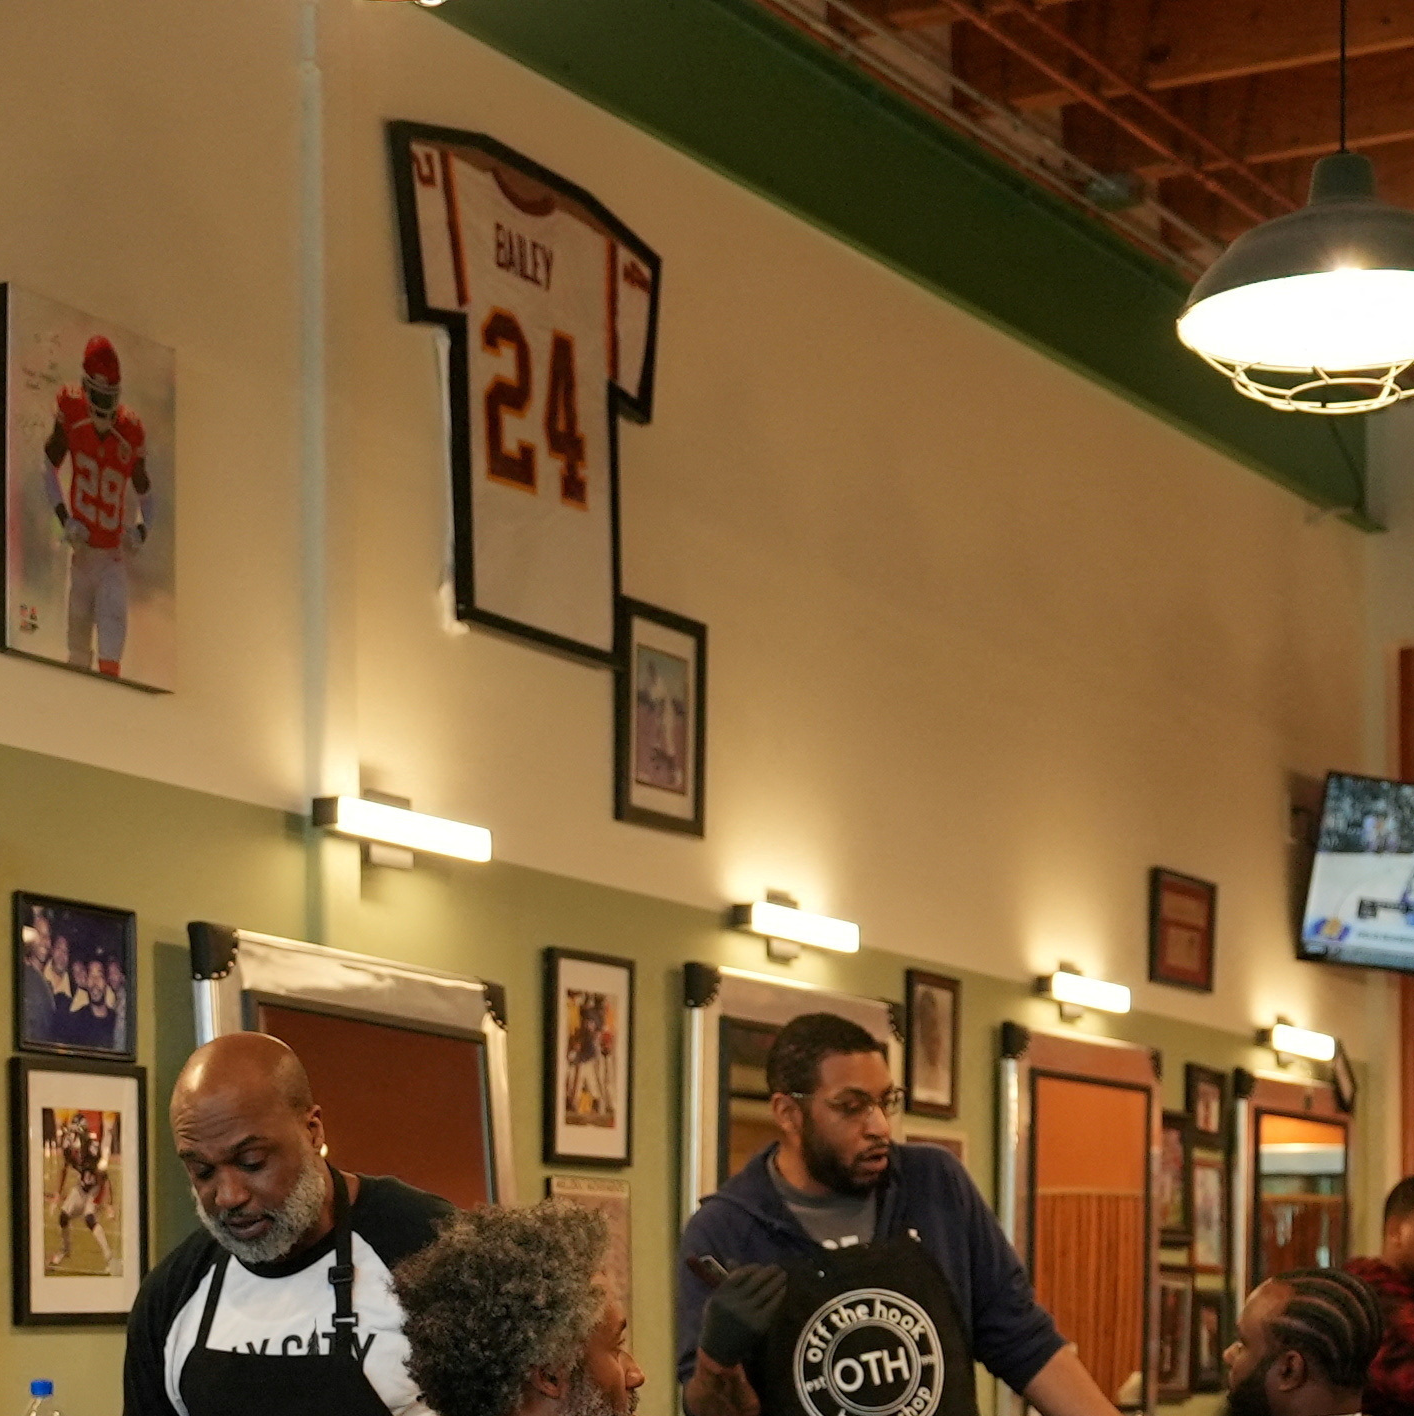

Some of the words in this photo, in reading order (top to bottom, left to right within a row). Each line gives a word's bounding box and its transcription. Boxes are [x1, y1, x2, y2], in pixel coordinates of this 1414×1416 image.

[481, 306, 588, 512] 24
[73, 454, 127, 531] 29
[805, 1321, 833, 1363] off
[829, 1304, 870, 1328] the
[873, 1299, 926, 1341] hook
[833, 1345, 910, 1393] OTH
